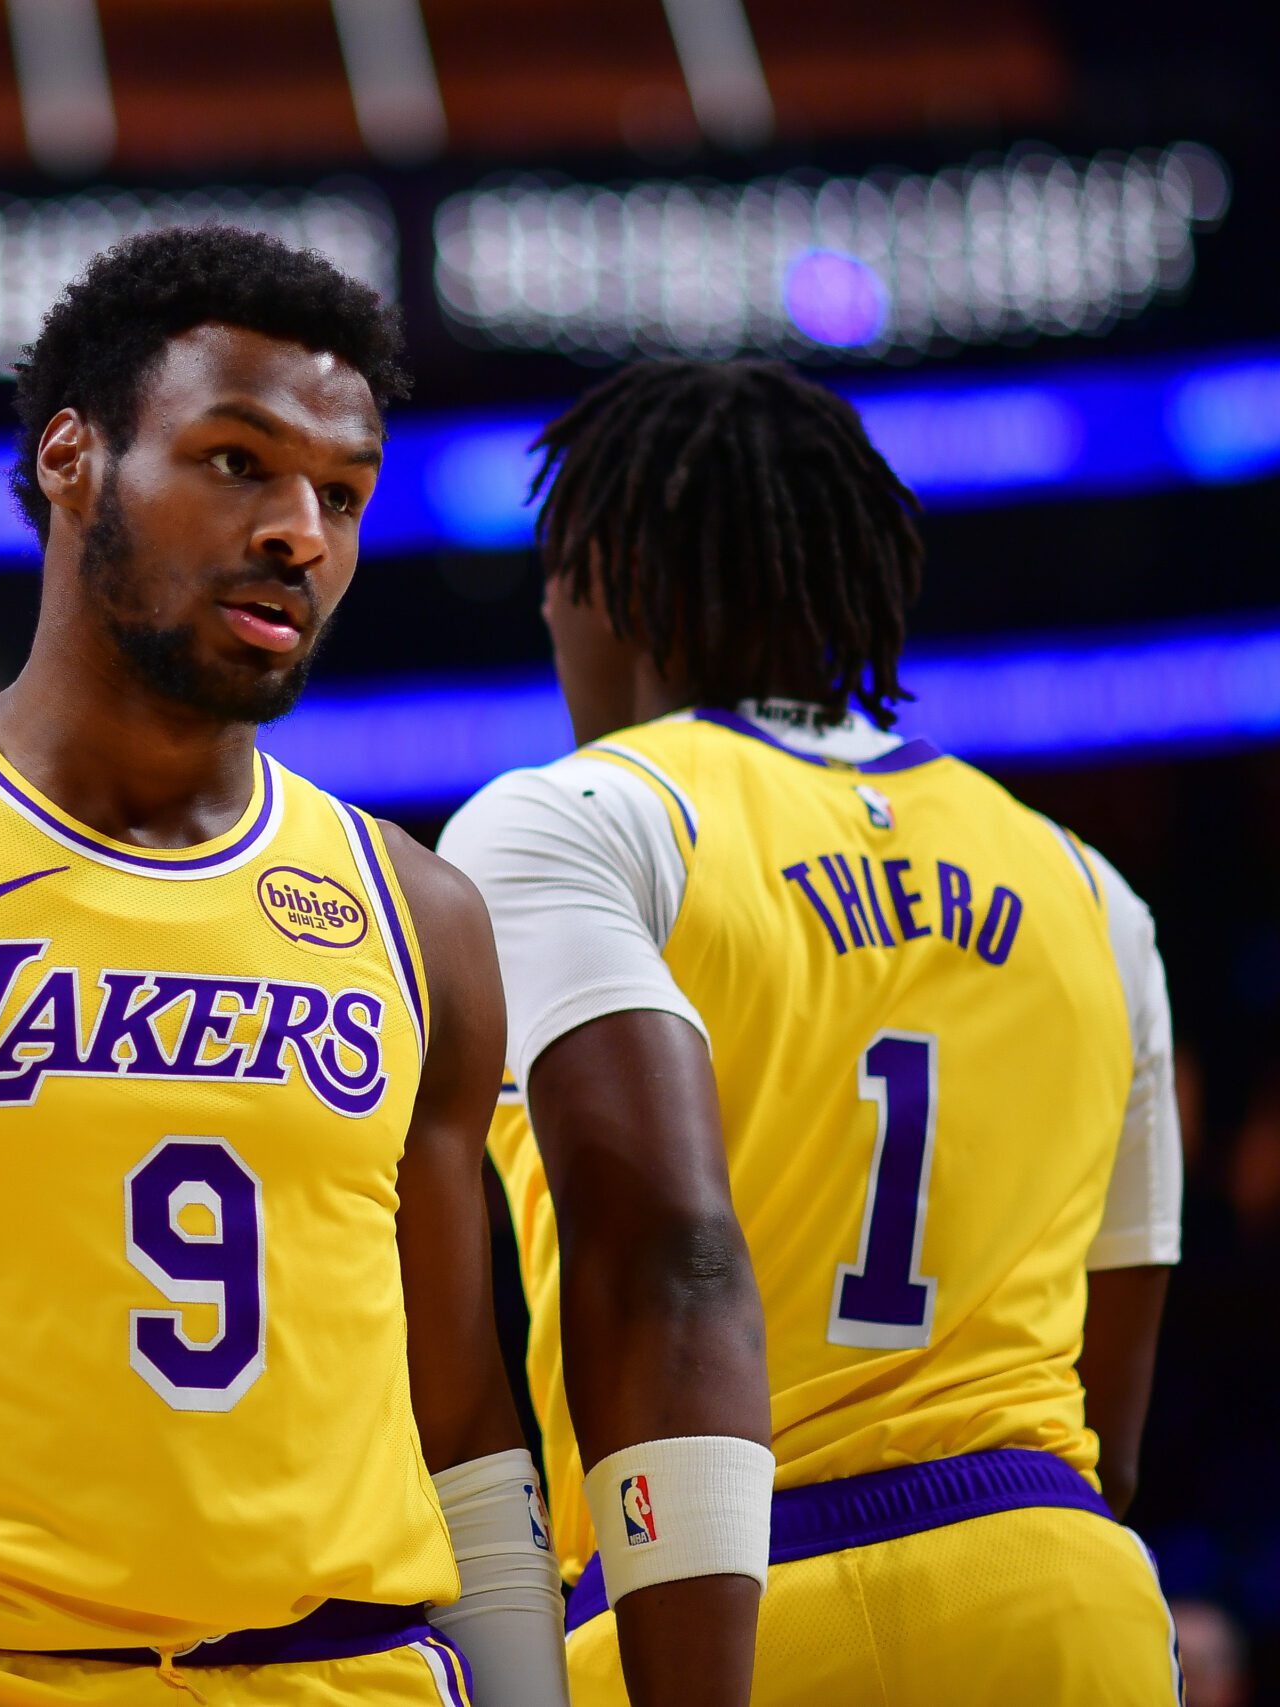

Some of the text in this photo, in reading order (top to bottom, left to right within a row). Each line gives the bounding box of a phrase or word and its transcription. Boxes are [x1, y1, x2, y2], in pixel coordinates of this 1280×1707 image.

[265, 882, 359, 929] bibigo
[780, 853, 1023, 967] THIERO
[826, 1027, 939, 1350] 1
[124, 1134, 267, 1413] 9
[629, 1531, 648, 1546] NBA
